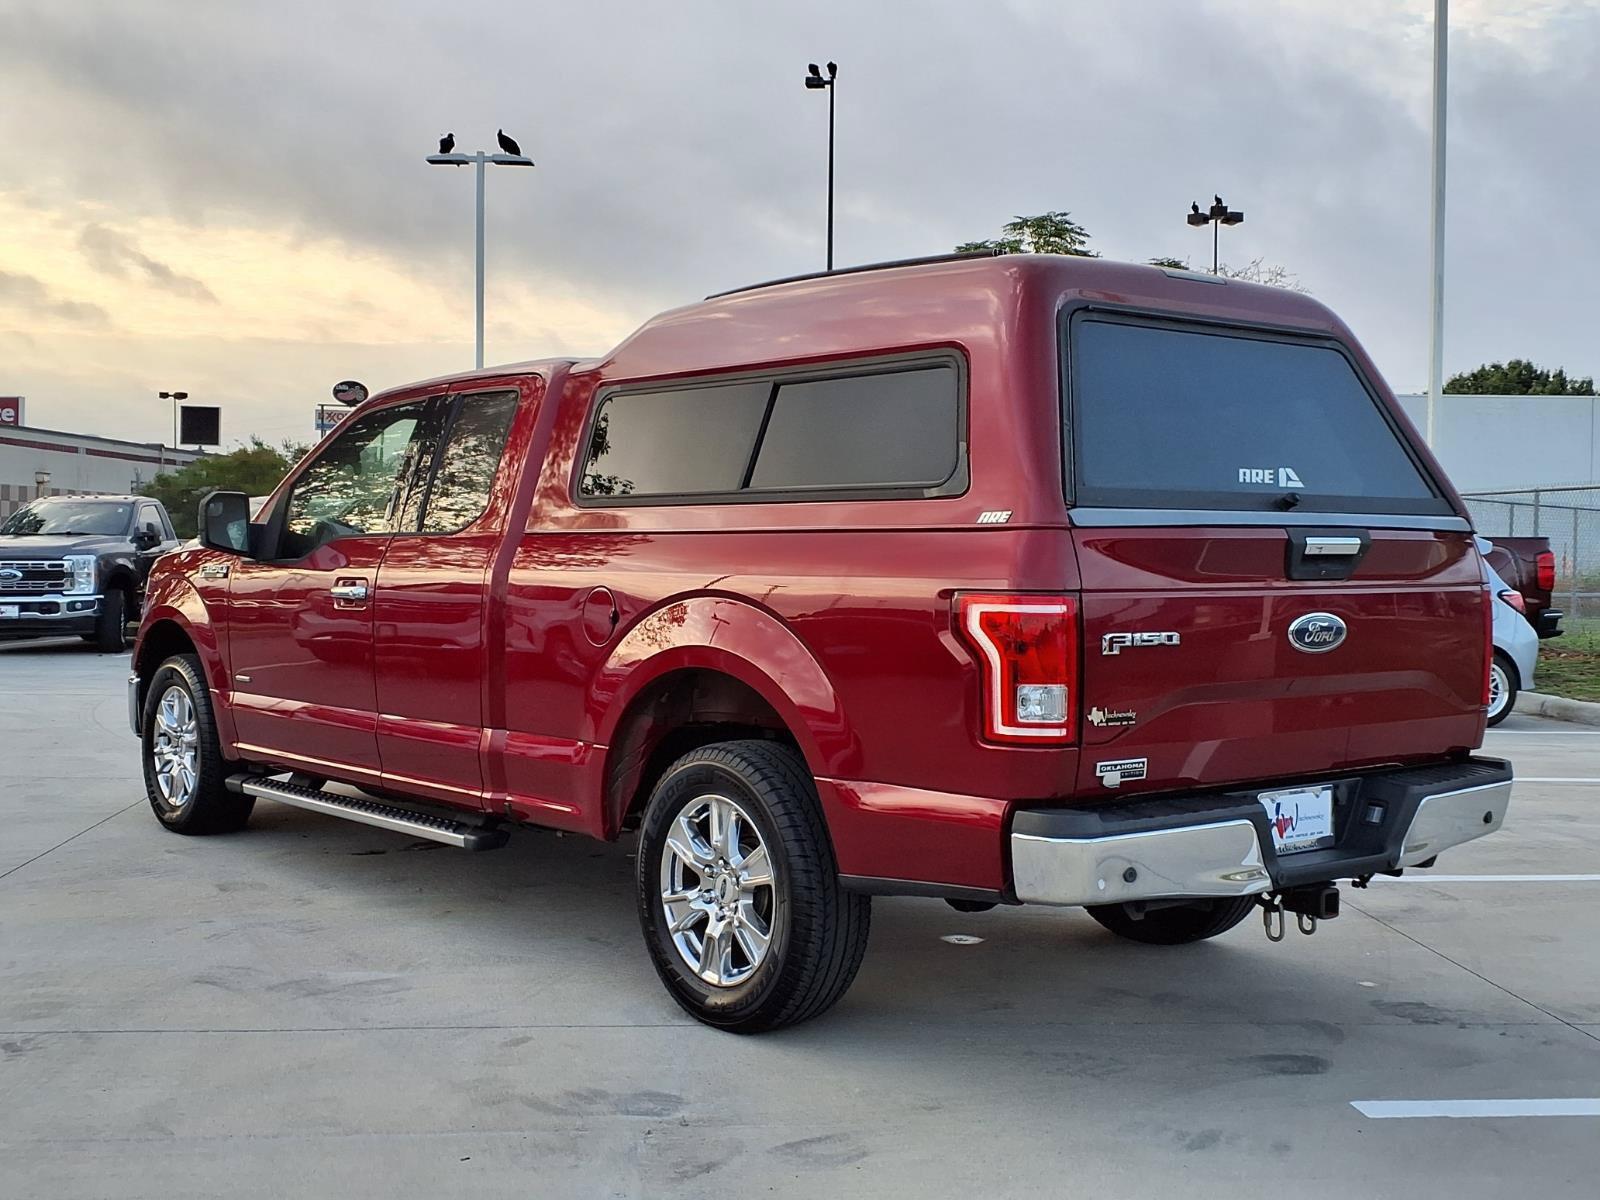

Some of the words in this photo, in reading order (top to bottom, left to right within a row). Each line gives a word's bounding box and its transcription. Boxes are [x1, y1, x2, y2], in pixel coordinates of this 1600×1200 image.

[1239, 468, 1274, 484] ARE
[976, 510, 1012, 524] ARE
[1304, 621, 1337, 643] Ford
[1101, 762, 1144, 772] OKLAHOMA
